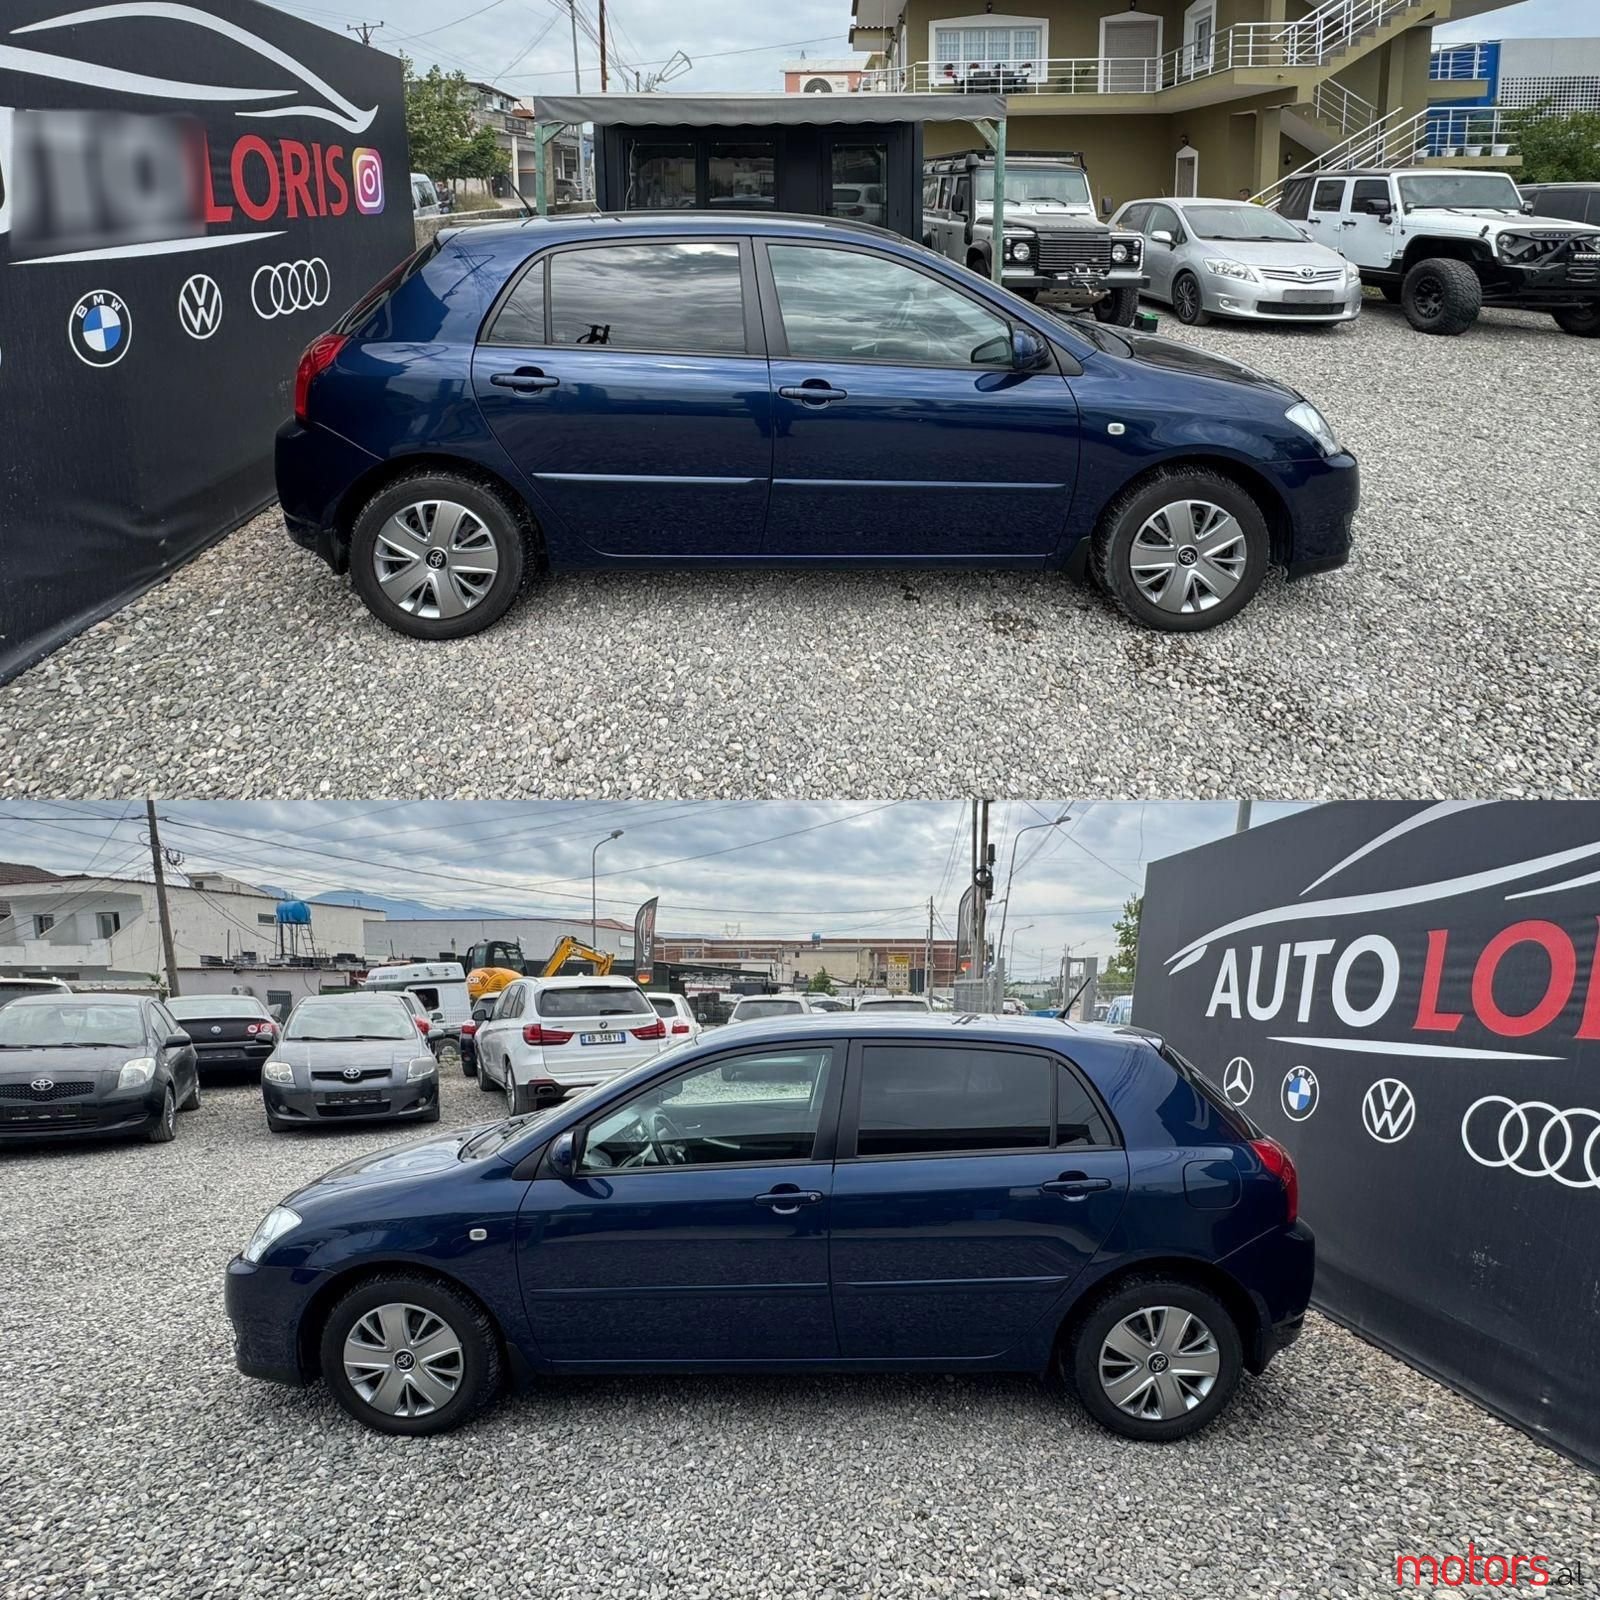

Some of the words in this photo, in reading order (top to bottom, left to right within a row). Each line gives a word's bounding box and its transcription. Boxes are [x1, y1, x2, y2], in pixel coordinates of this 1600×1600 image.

[75, 294, 122, 319] BMW
[1205, 934, 1400, 1028] AUTO
[1412, 912, 1600, 1040] LO
[1286, 1068, 1315, 1086] BMW
